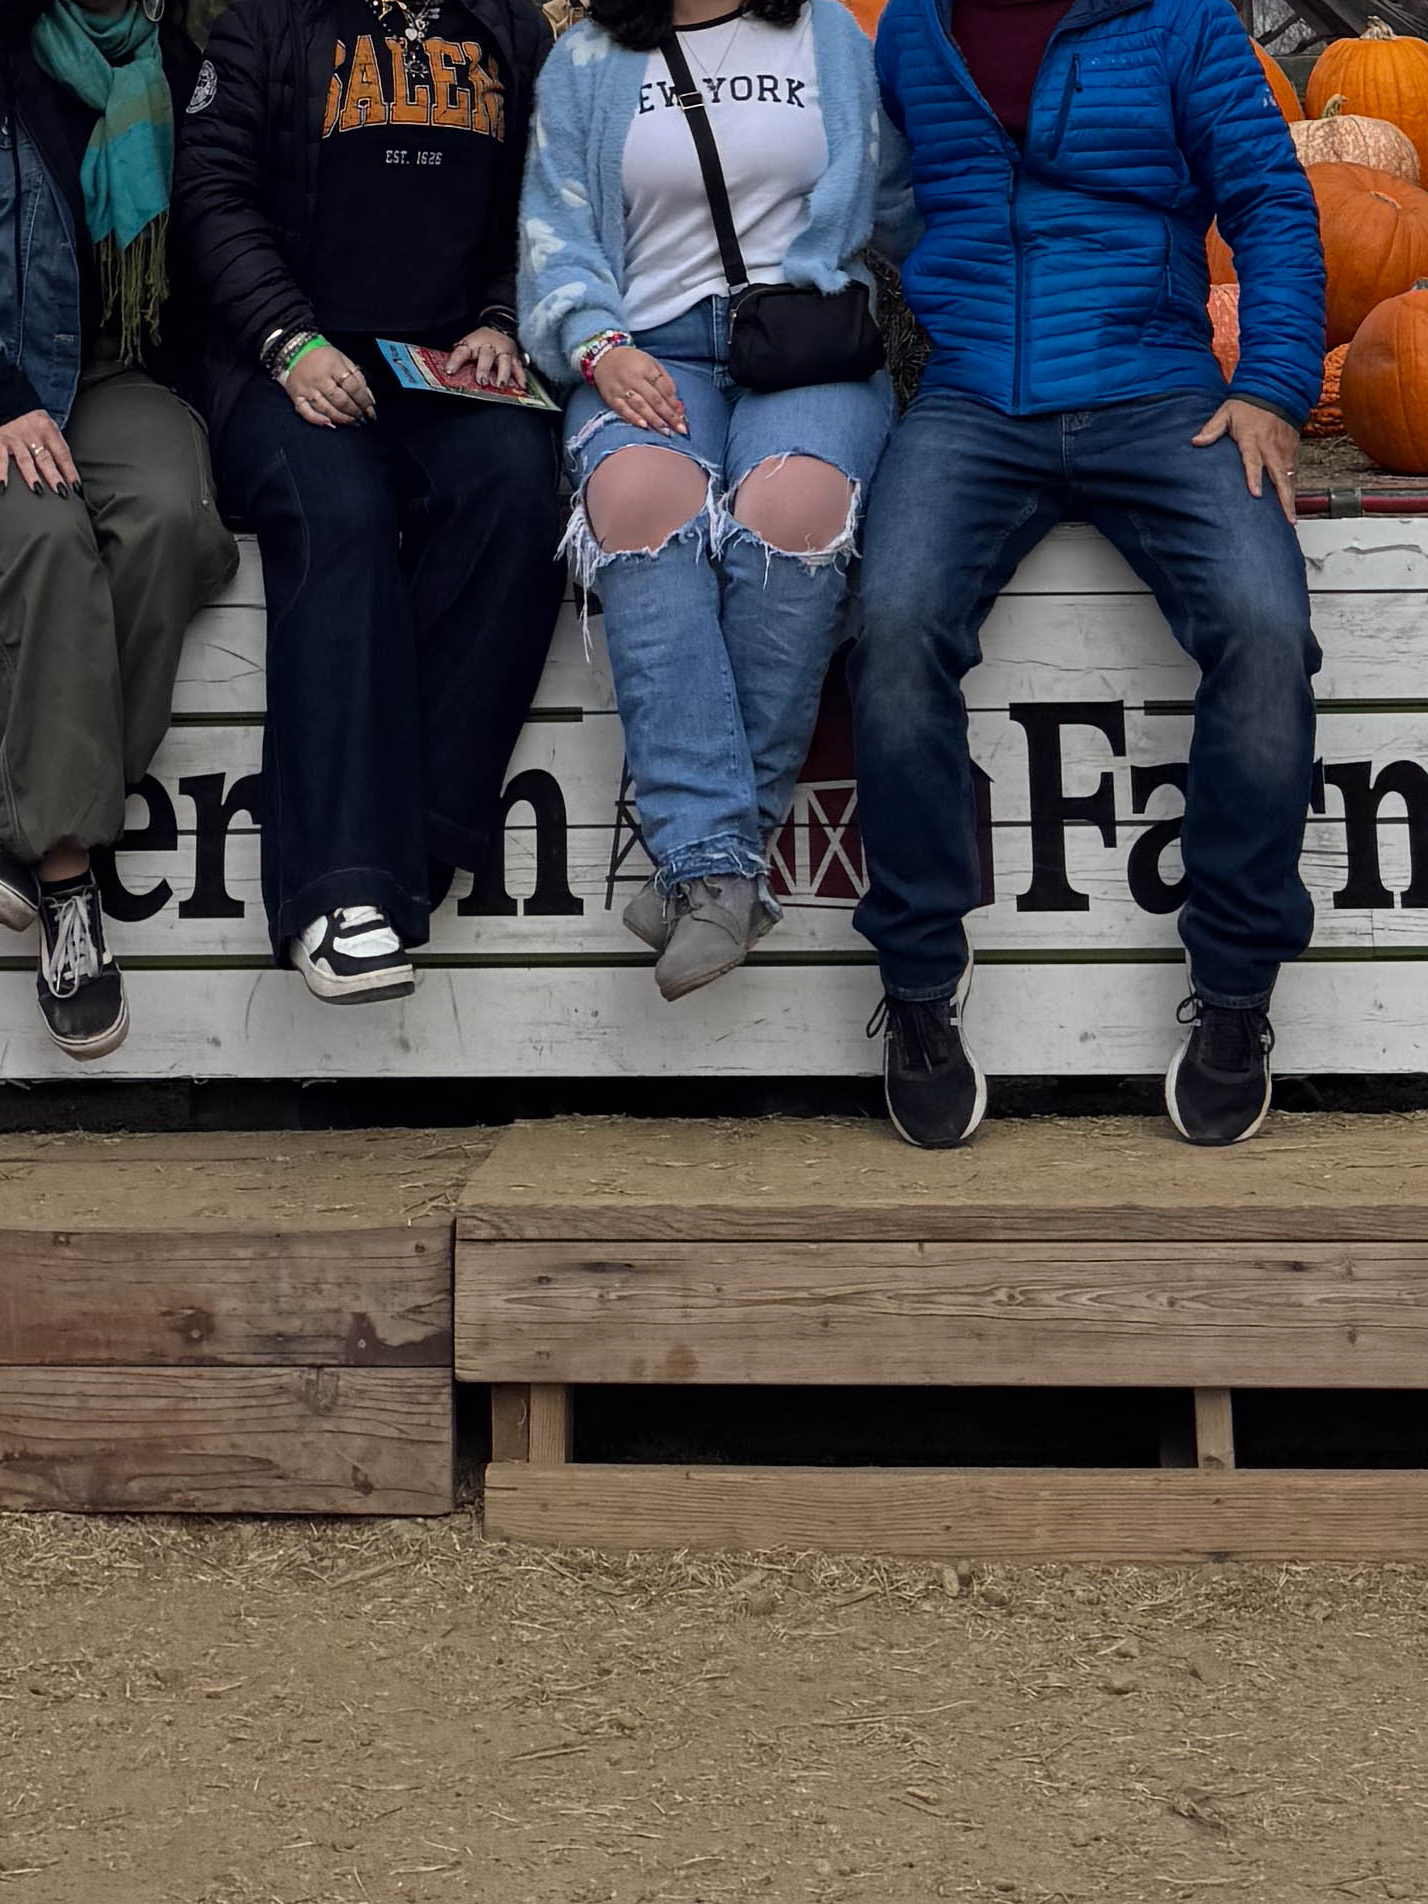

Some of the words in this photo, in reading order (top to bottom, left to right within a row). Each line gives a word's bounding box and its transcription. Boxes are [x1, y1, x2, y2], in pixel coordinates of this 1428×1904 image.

[639, 80, 681, 114] EW
[702, 74, 805, 108] YORK
[385, 149, 410, 165] EST.
[416, 151, 443, 165] 1626
